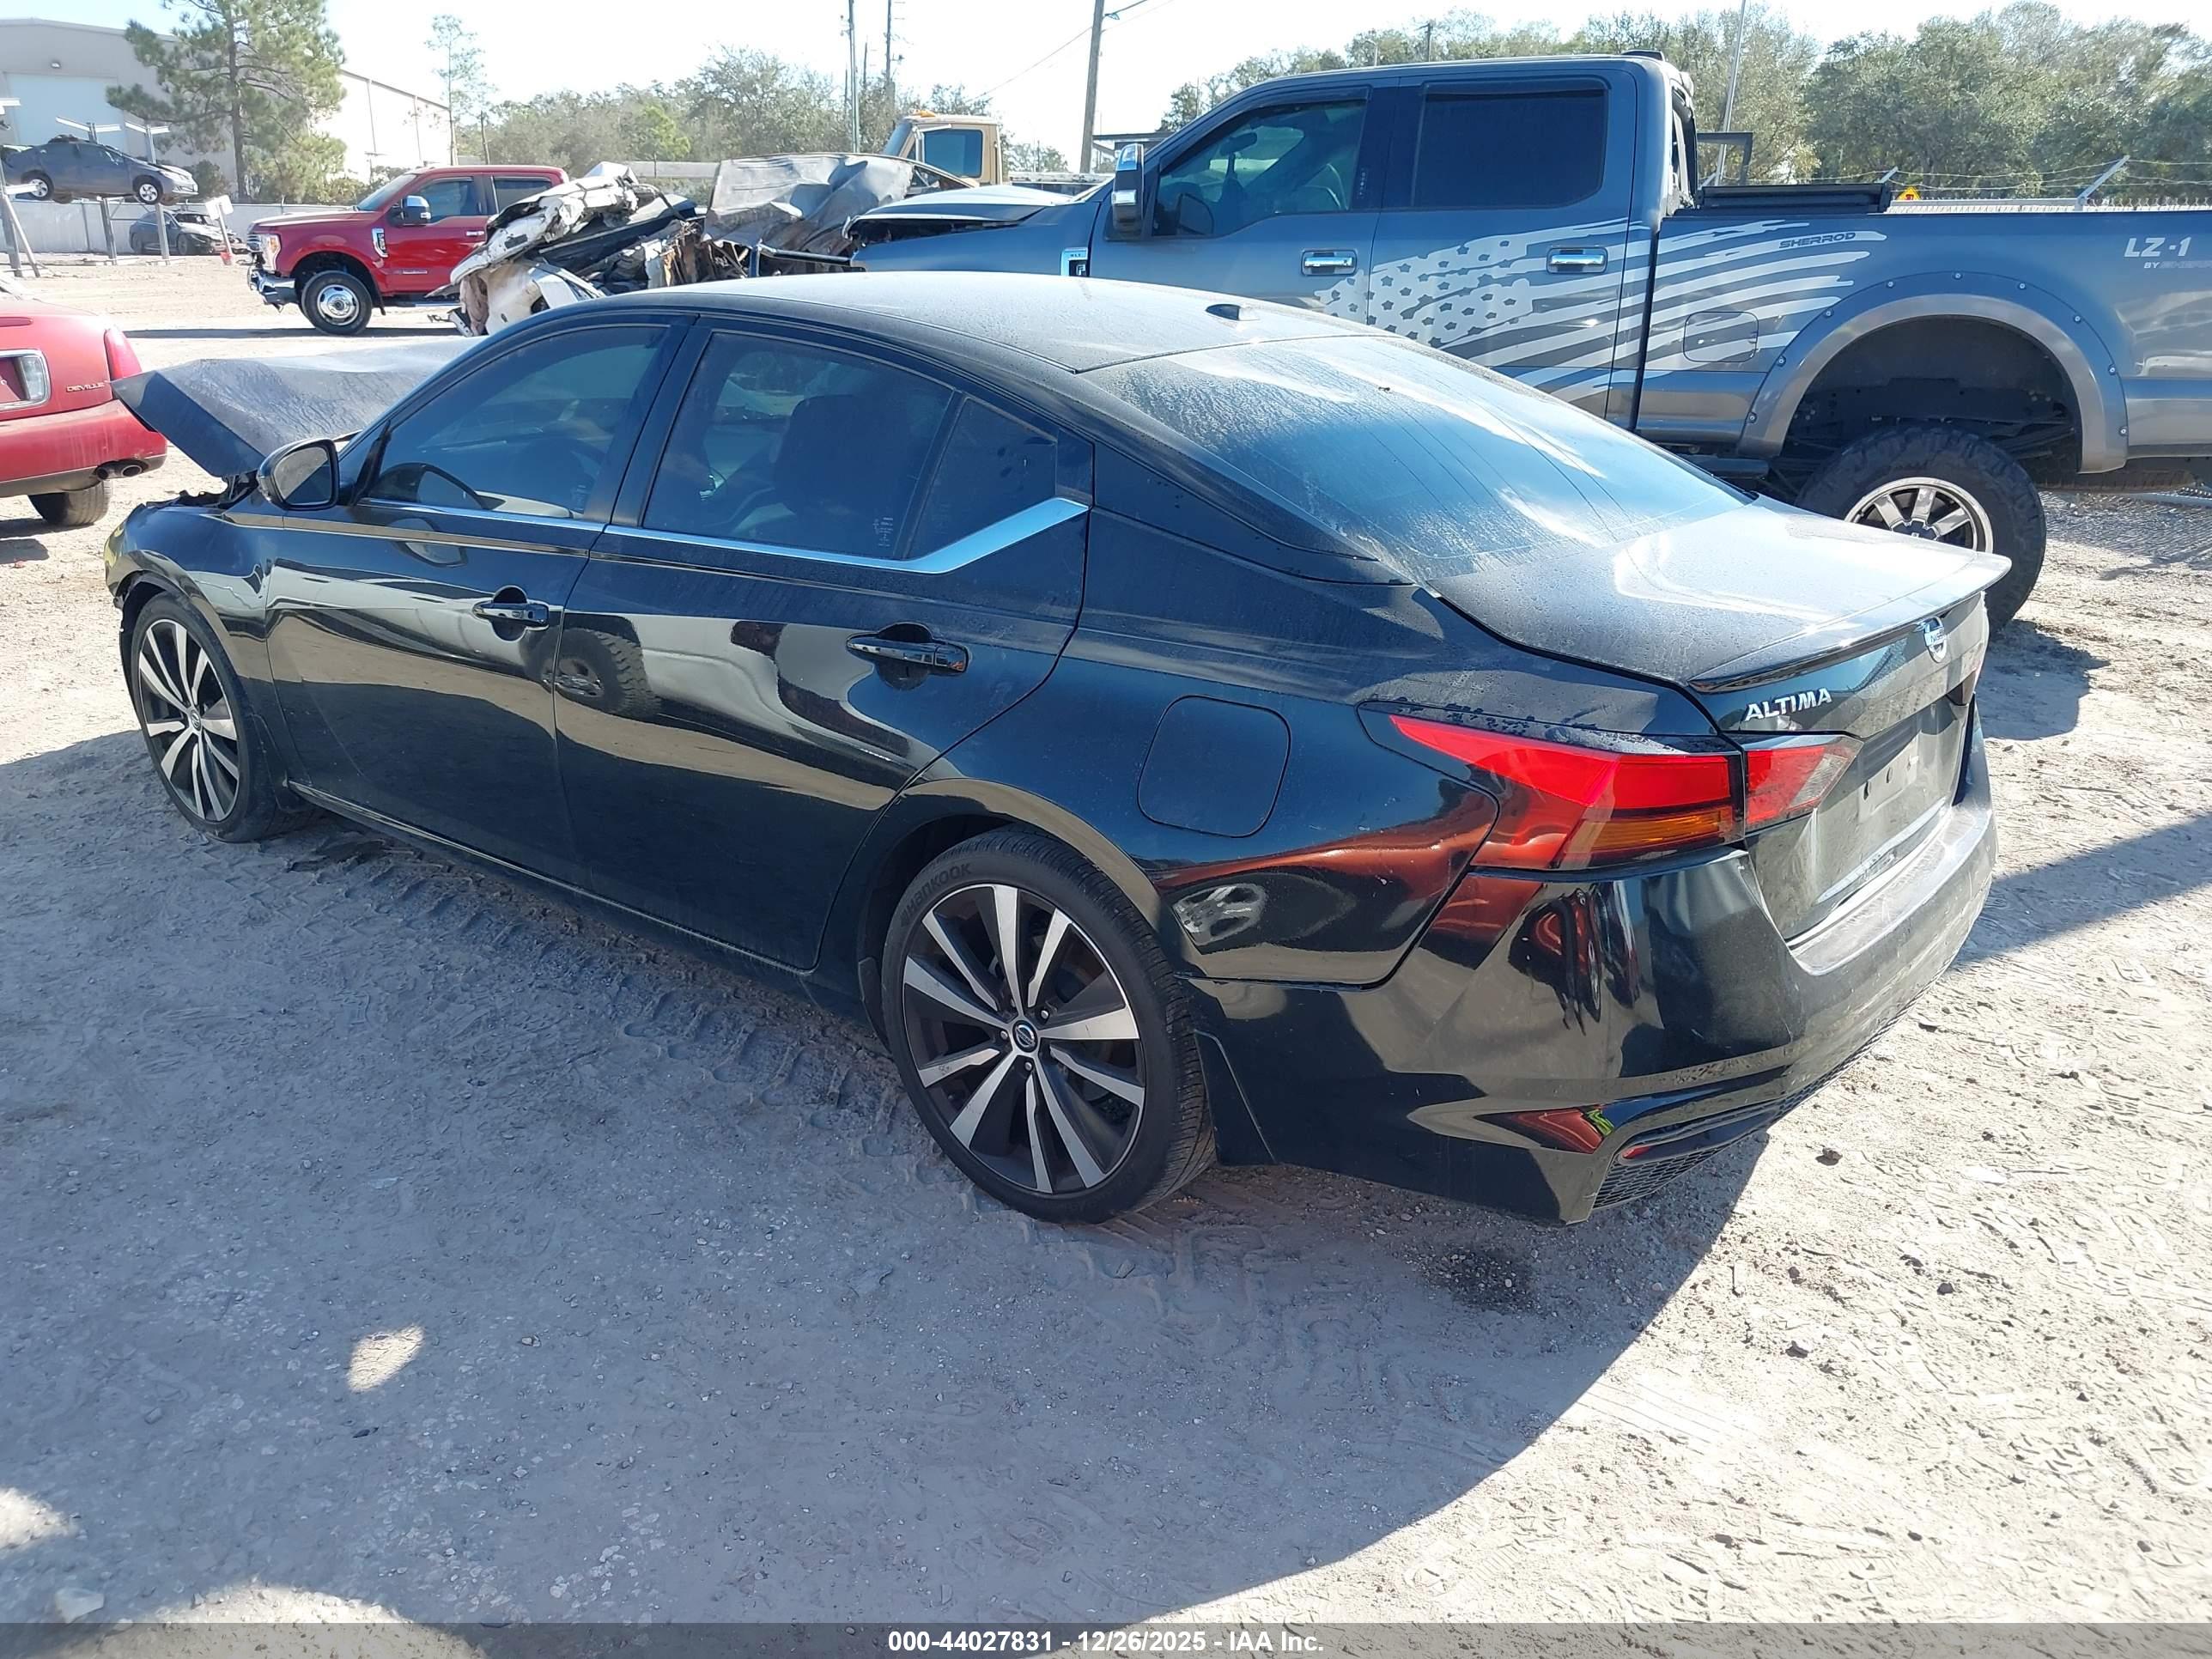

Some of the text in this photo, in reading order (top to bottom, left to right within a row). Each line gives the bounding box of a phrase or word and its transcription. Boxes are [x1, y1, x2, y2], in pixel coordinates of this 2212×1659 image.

[1778, 232, 1856, 249] SHERROD
[65, 382, 106, 392] DEVILLE
[1744, 687, 1832, 722] ALTIMA
